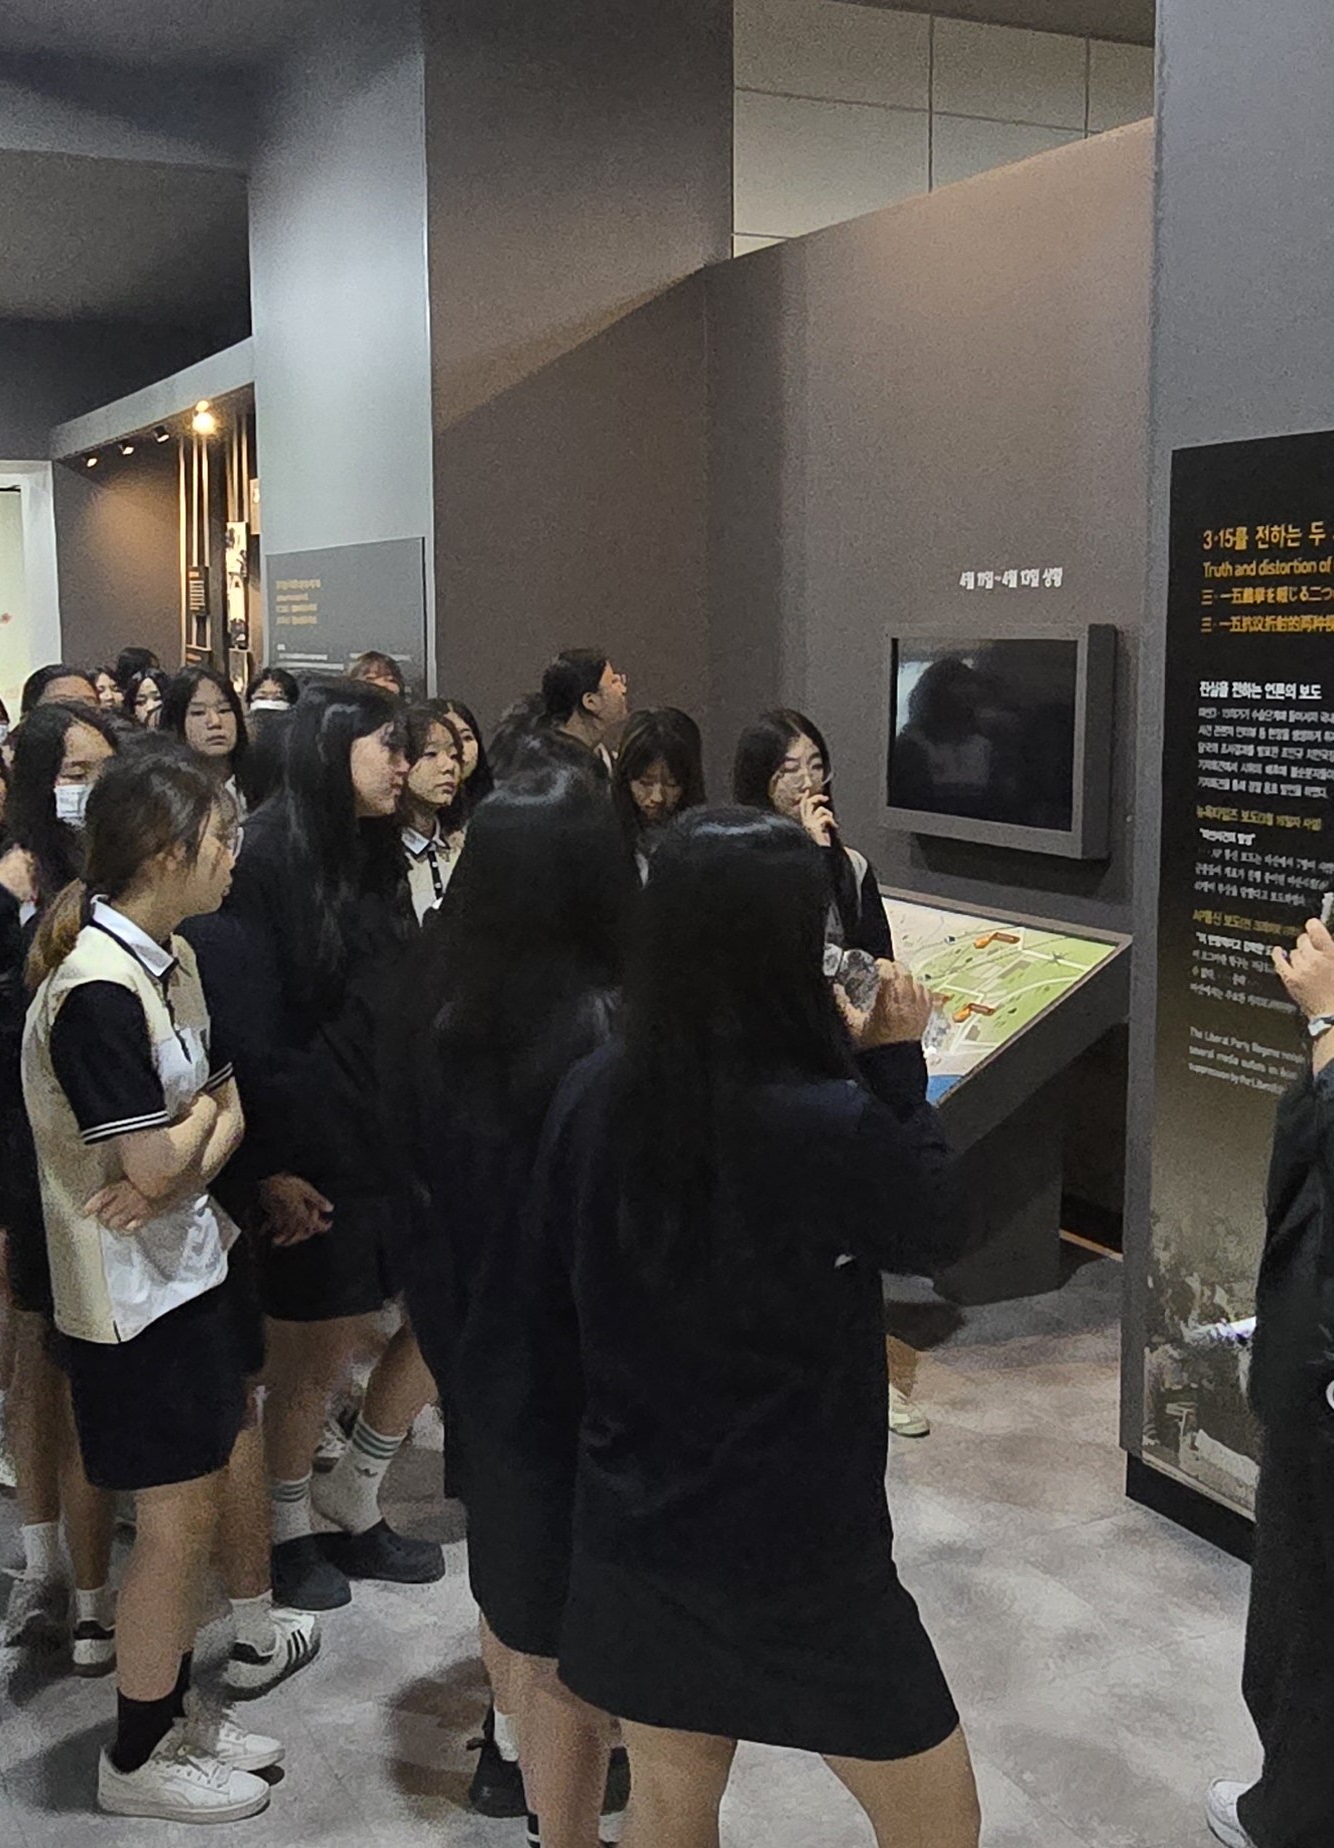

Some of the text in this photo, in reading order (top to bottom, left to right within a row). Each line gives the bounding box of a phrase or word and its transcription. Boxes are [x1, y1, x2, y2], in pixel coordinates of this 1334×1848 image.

[1255, 523, 1302, 549] 전하는
[1307, 520, 1326, 547] 두
[1203, 561, 1233, 579] Truth
[1234, 559, 1257, 578] and
[1257, 557, 1317, 576] distortion
[1318, 556, 1332, 574] of
[1199, 680, 1323, 700] 진실을 전하는 언론의 보도
